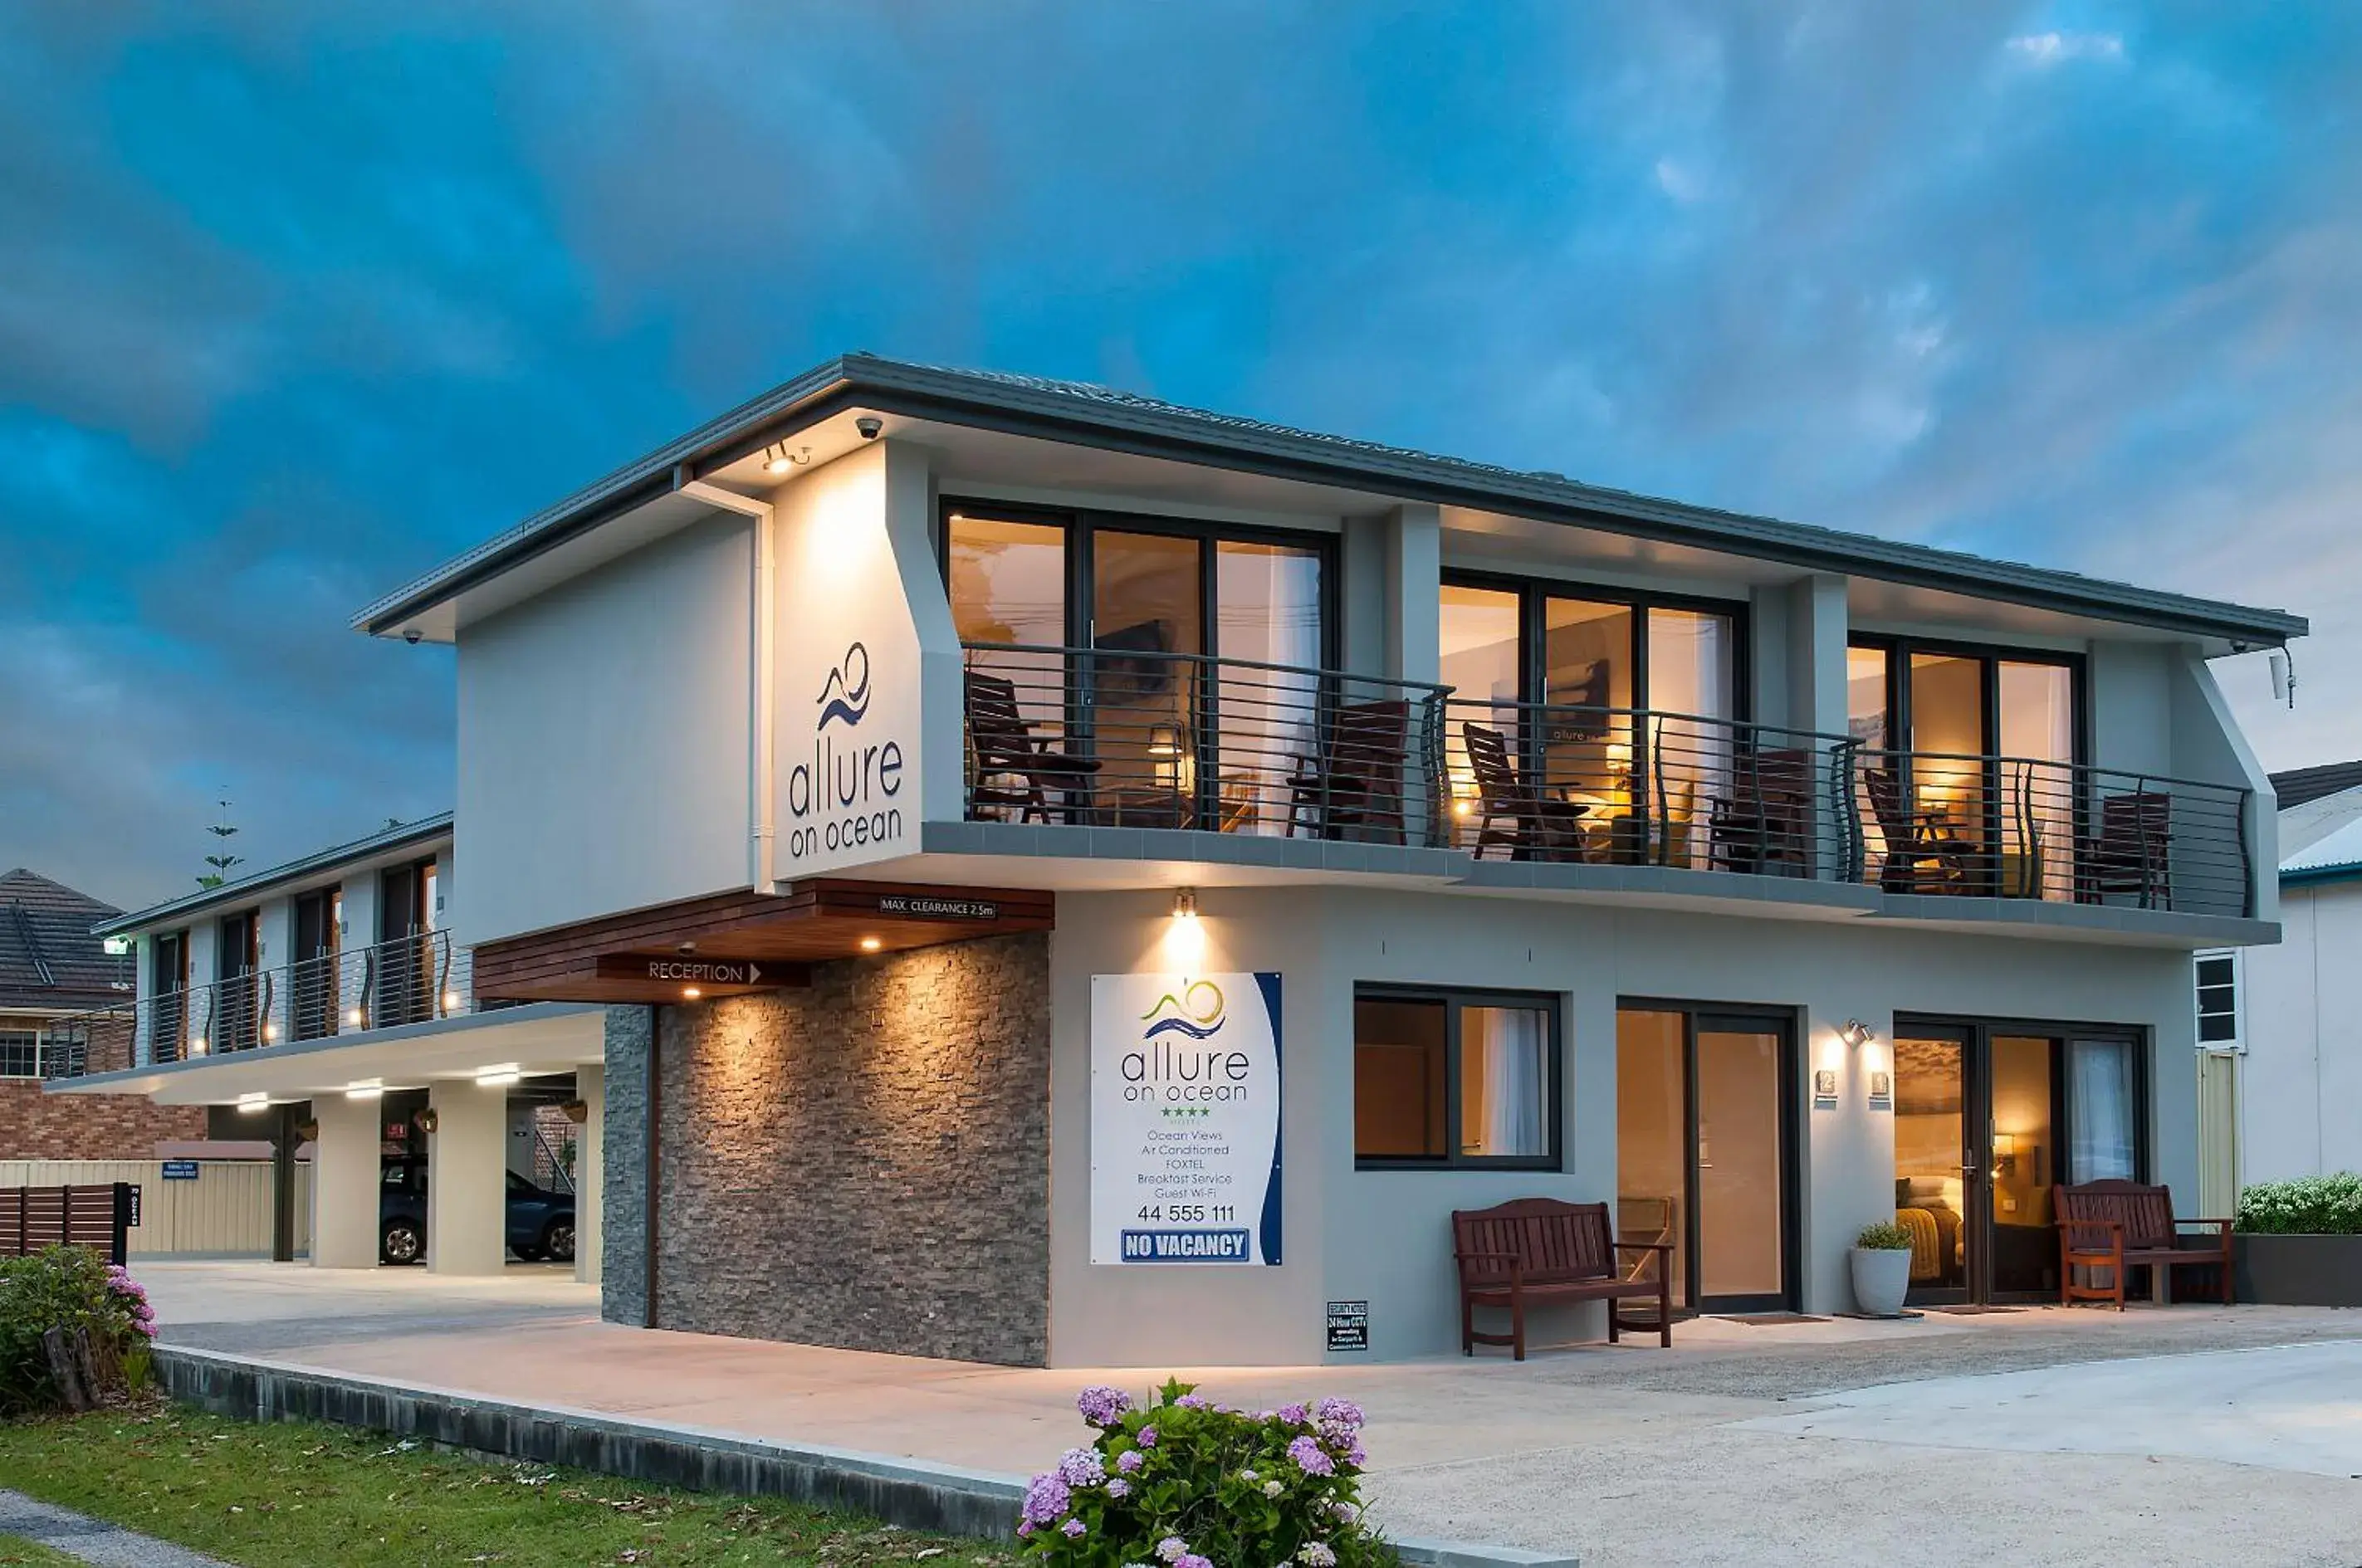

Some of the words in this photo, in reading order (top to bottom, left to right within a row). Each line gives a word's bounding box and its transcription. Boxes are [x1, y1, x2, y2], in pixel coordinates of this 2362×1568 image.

[790, 735, 902, 817] allure
[791, 825, 818, 857] on
[826, 808, 902, 851] ocean
[911, 901, 967, 913] CLEARANCE
[649, 961, 743, 981] RECEPTION
[1122, 1042, 1249, 1081] allure
[1123, 1084, 1155, 1102] on
[1166, 1083, 1246, 1102] ocean
[1147, 1130, 1188, 1141] Ocean
[1191, 1131, 1222, 1141] Views
[1142, 1145, 1156, 1155] Air
[1158, 1145, 1229, 1155] Conditioned
[1166, 1160, 1204, 1170] FOXTEL
[1137, 1174, 1189, 1184] Breakfast
[1191, 1174, 1232, 1184] Service
[1155, 1188, 1187, 1199] Guest
[1190, 1188, 1216, 1198] Wi-Fi
[1137, 1205, 1161, 1222] 44
[1169, 1205, 1205, 1222] 555
[1212, 1205, 1235, 1222] 111
[1126, 1234, 1152, 1257] NO
[1156, 1233, 1245, 1257] VACANCY
